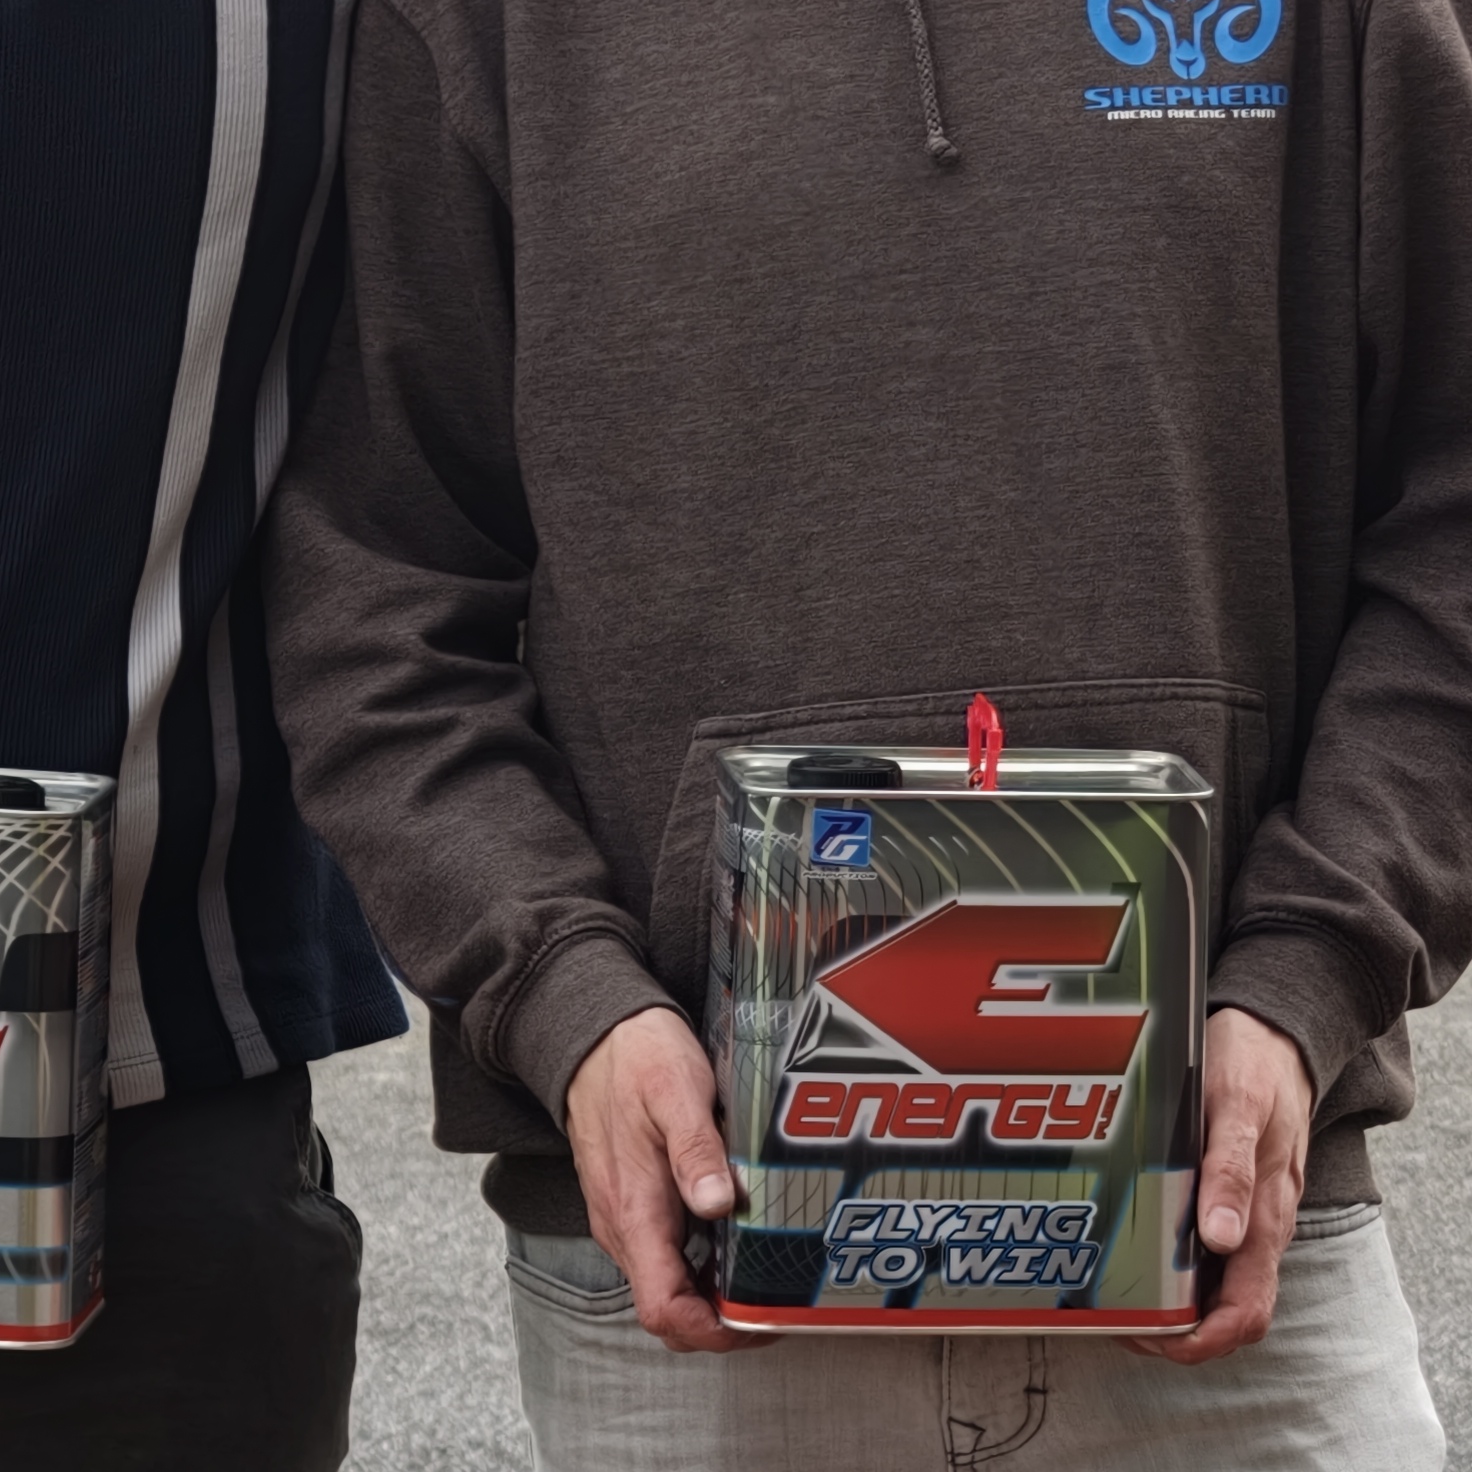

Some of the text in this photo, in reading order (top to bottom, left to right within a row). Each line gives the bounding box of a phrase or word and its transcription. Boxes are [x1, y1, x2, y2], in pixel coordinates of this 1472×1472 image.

[1084, 83, 1289, 110] SHEPHERD
[1107, 109, 1276, 120] MICRO RACING TEAM
[830, 1201, 1091, 1245] FLYING
[831, 1242, 1098, 1288] TO WIN
